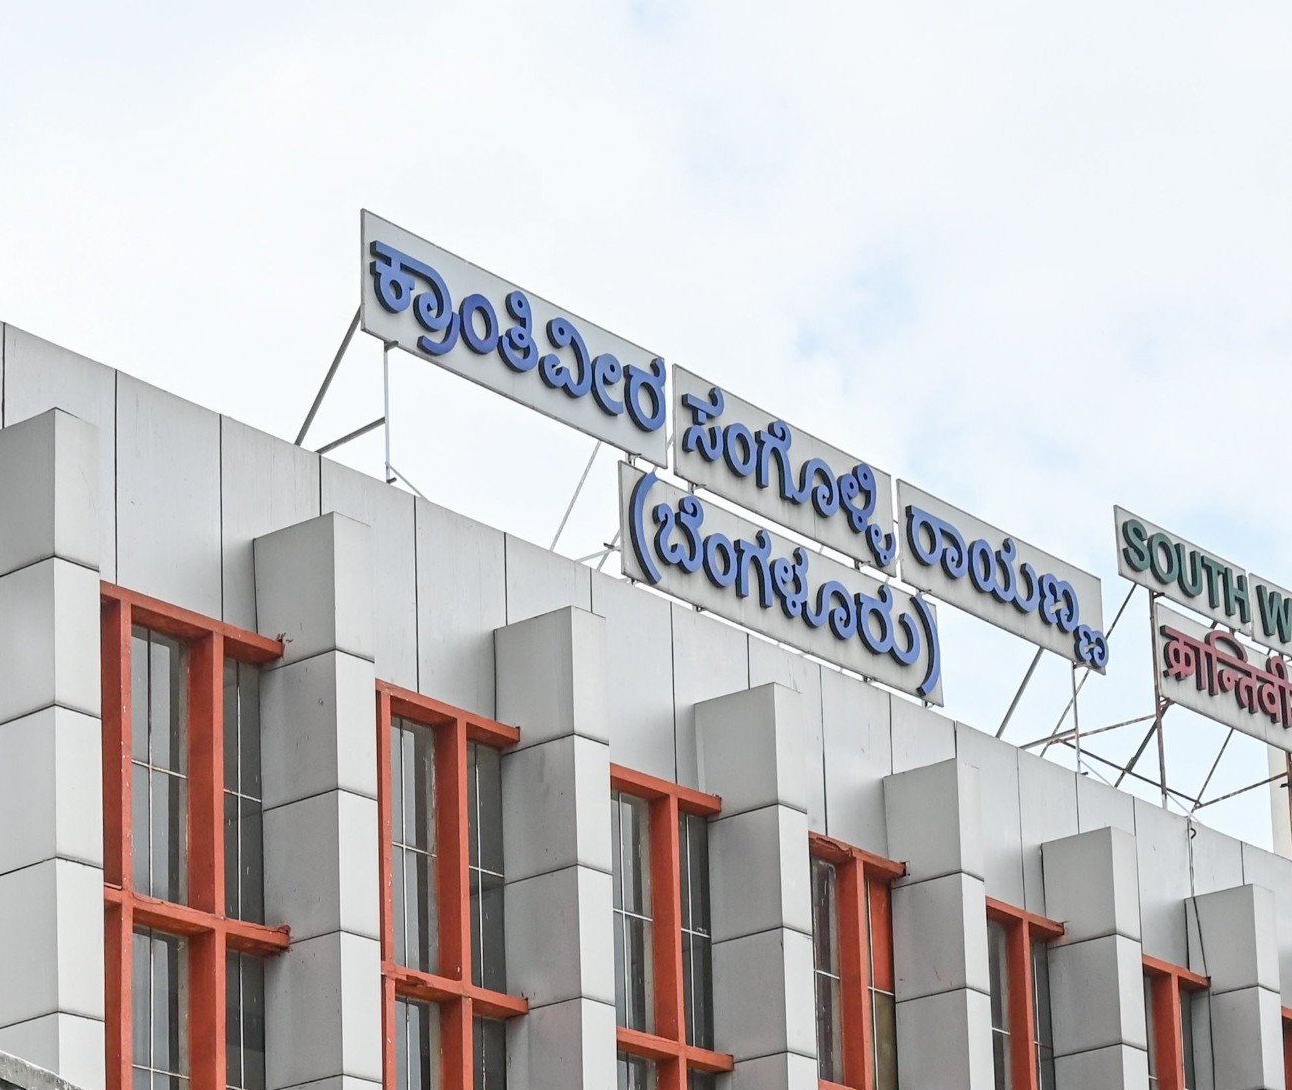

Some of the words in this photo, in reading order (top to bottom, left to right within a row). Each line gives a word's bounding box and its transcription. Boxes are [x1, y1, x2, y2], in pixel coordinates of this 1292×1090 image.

[369, 239, 667, 433] ಕ್ರಾಂತಿವೀರ
[681, 386, 897, 568] ಸಂಗೊಳ್ಳಿ
[905, 503, 1109, 670] ರಾಯಣ್ಣ
[628, 470, 942, 697] (ಬೆಂಗಳೂರು)
[1121, 518, 1251, 624] SOUTH
